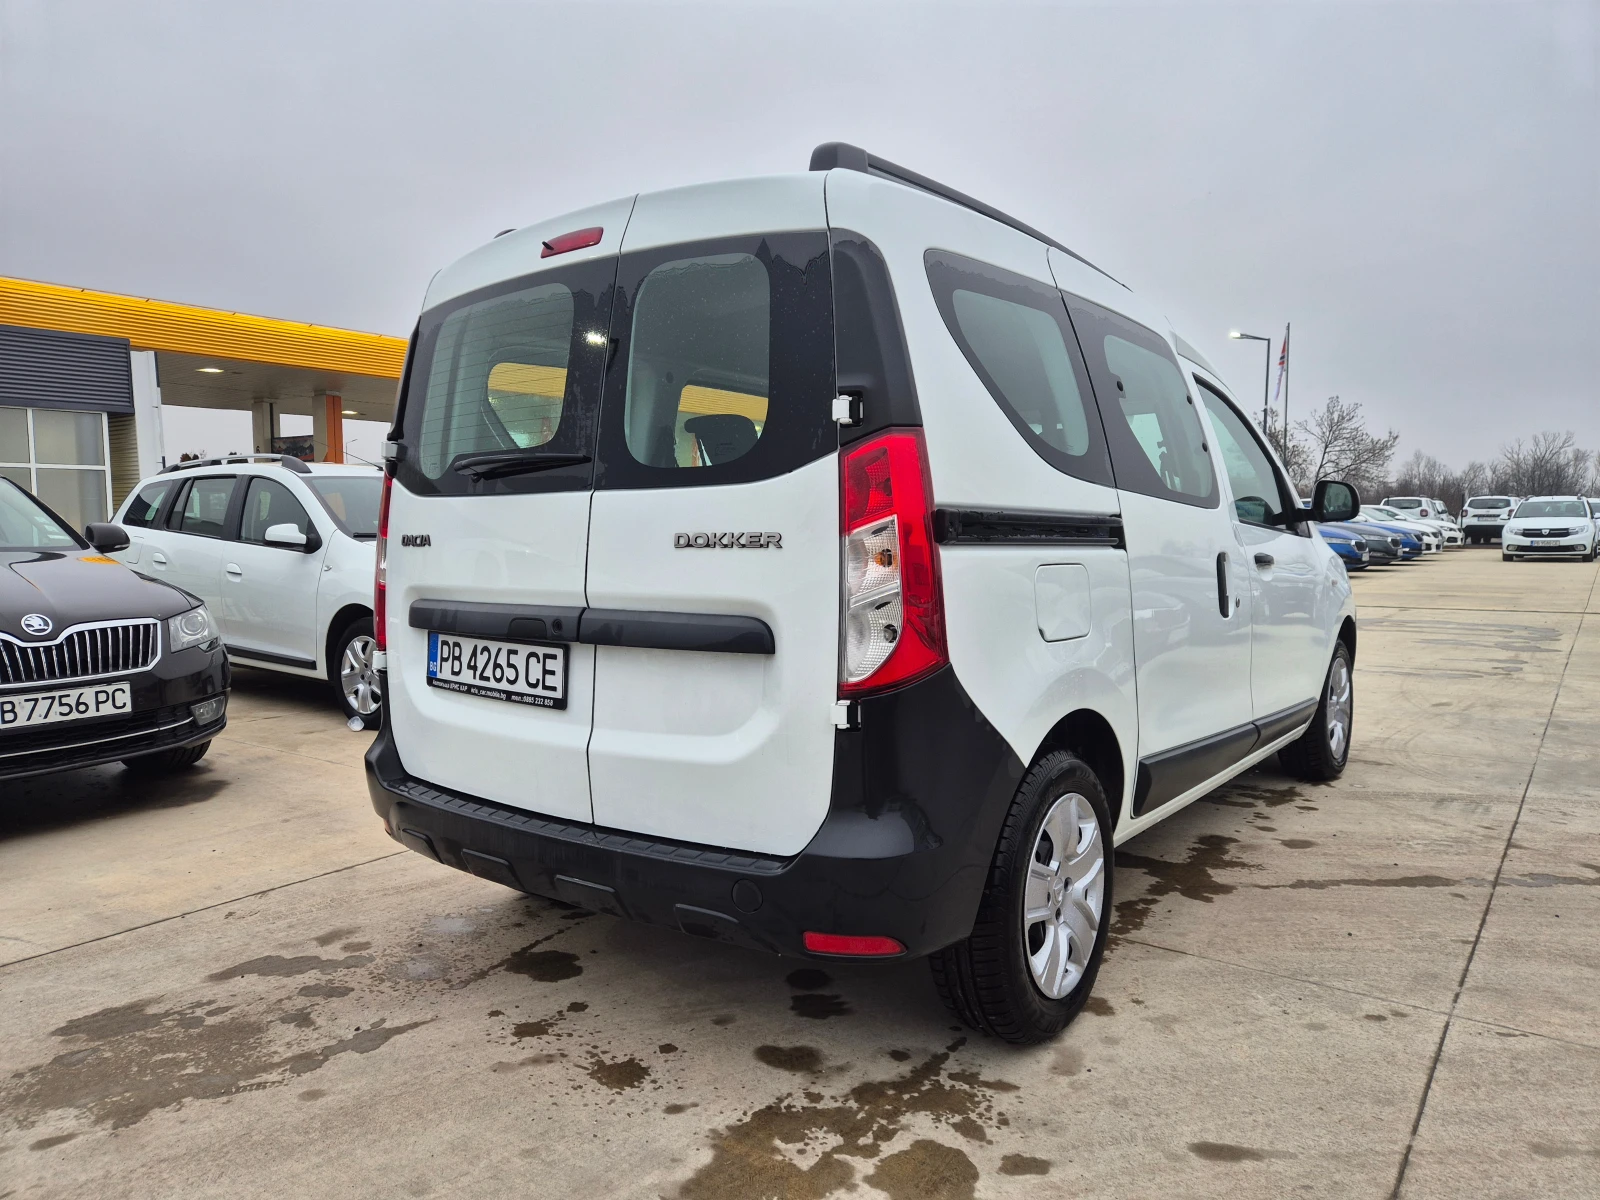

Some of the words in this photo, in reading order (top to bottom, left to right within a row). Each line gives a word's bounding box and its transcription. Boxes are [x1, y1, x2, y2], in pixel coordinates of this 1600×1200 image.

[401, 534, 431, 547] DACIA
[673, 531, 783, 549] DOKKER
[429, 661, 437, 671] BG
[439, 639, 463, 677] PB
[466, 644, 519, 686] 4265
[525, 651, 558, 692] CE
[0, 700, 18, 724] B
[24, 692, 89, 722] 7756
[95, 687, 127, 713] PC
